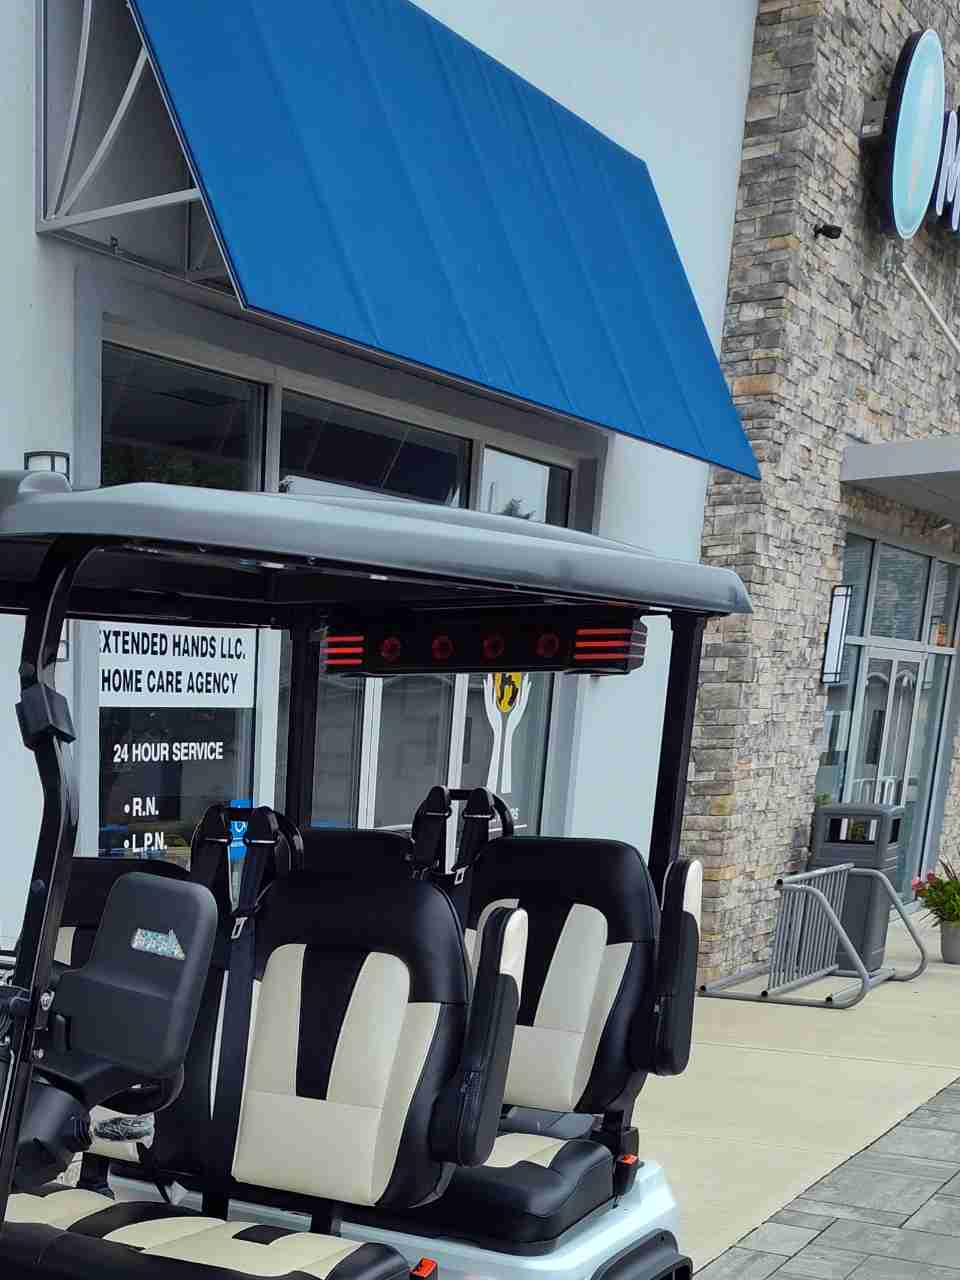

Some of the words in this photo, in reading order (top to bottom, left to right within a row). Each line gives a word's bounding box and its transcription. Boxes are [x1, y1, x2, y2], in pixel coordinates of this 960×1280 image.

[99, 630, 168, 655] XTENDED
[172, 634, 217, 658] HANDS
[220, 637, 246, 660] LLC.
[101, 669, 142, 692] HOME
[146, 670, 183, 693] CARE
[186, 672, 238, 694] AGENCY
[113, 743, 129, 763] 24
[132, 742, 170, 762] HOUR
[172, 741, 224, 761] SERVICE
[132, 797, 159, 817] R.N.
[132, 832, 168, 853] L.P.N.
